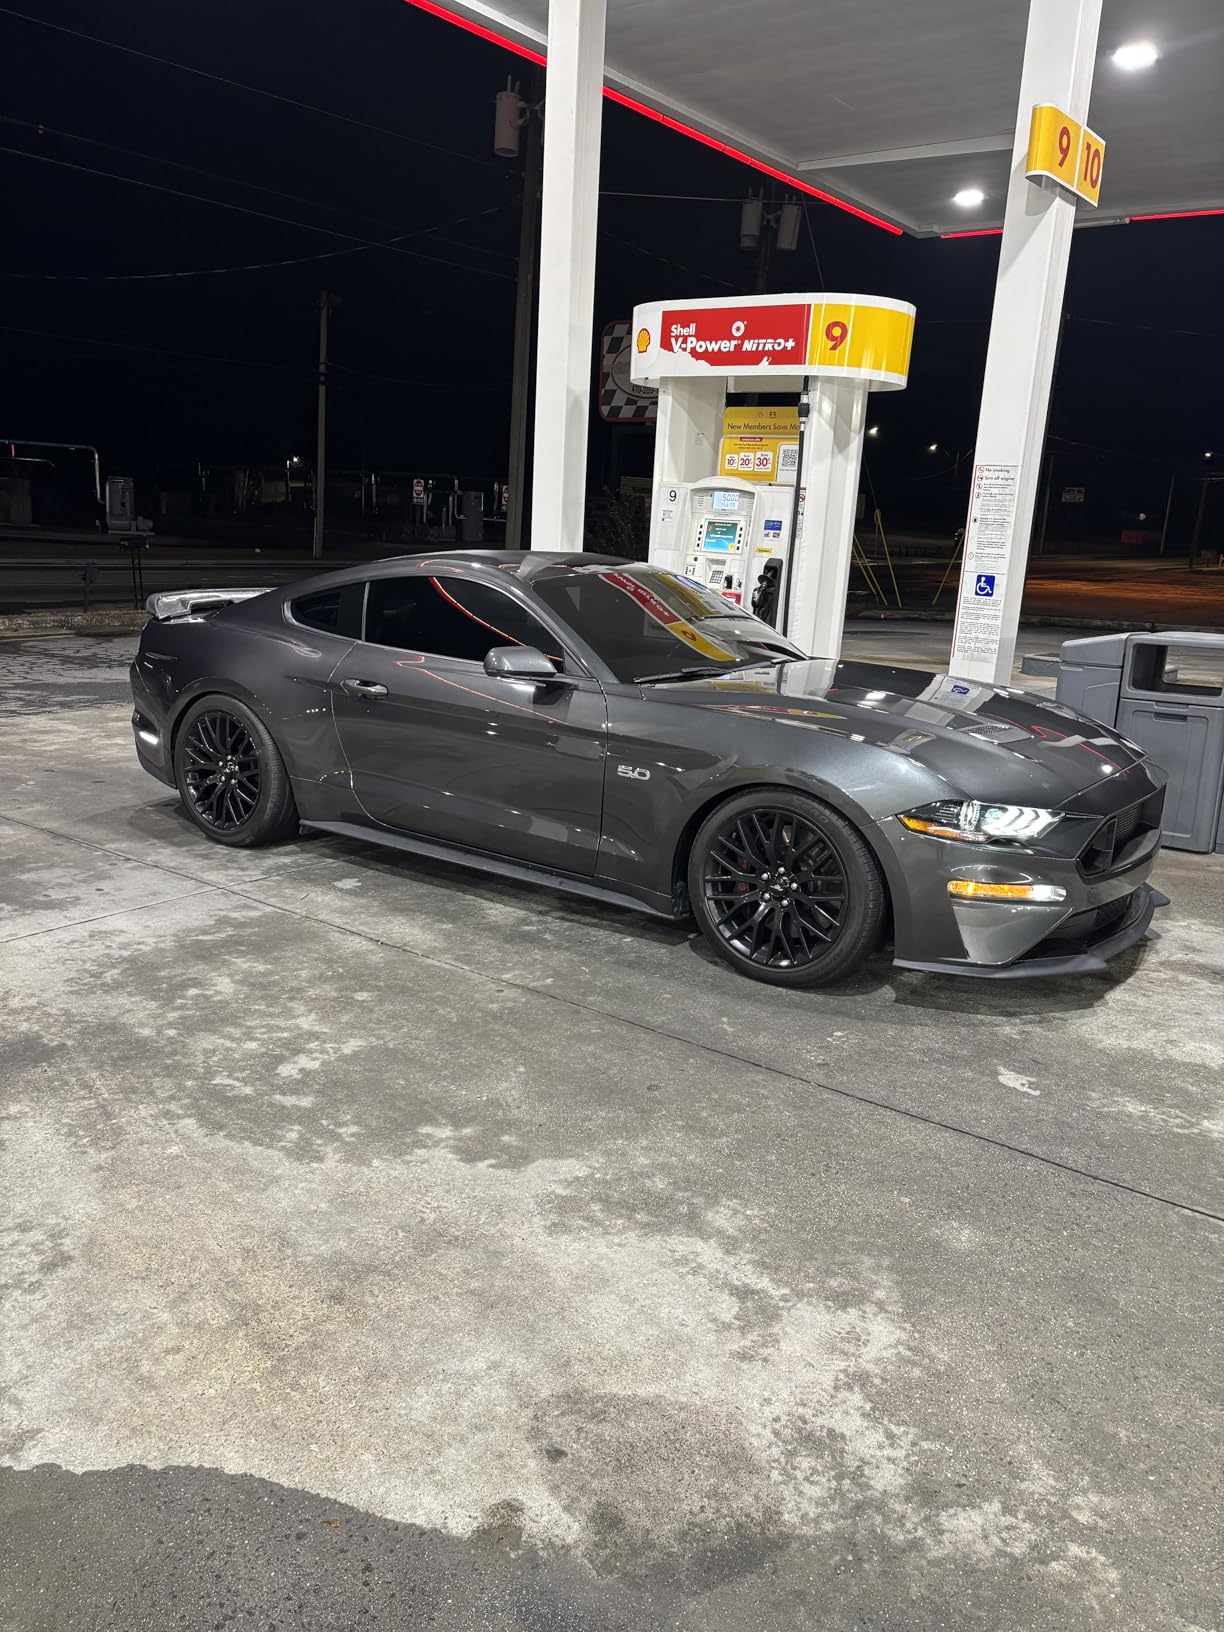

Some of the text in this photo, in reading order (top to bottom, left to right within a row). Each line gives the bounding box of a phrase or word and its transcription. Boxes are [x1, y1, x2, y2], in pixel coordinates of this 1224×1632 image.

[1058, 126, 1071, 168] 9
[1083, 141, 1101, 189] 10
[670, 323, 696, 336] Shell
[825, 321, 848, 351] 9
[671, 337, 796, 353] V-Power NITRO+
[743, 423, 772, 431] Members
[669, 490, 677, 502] 9
